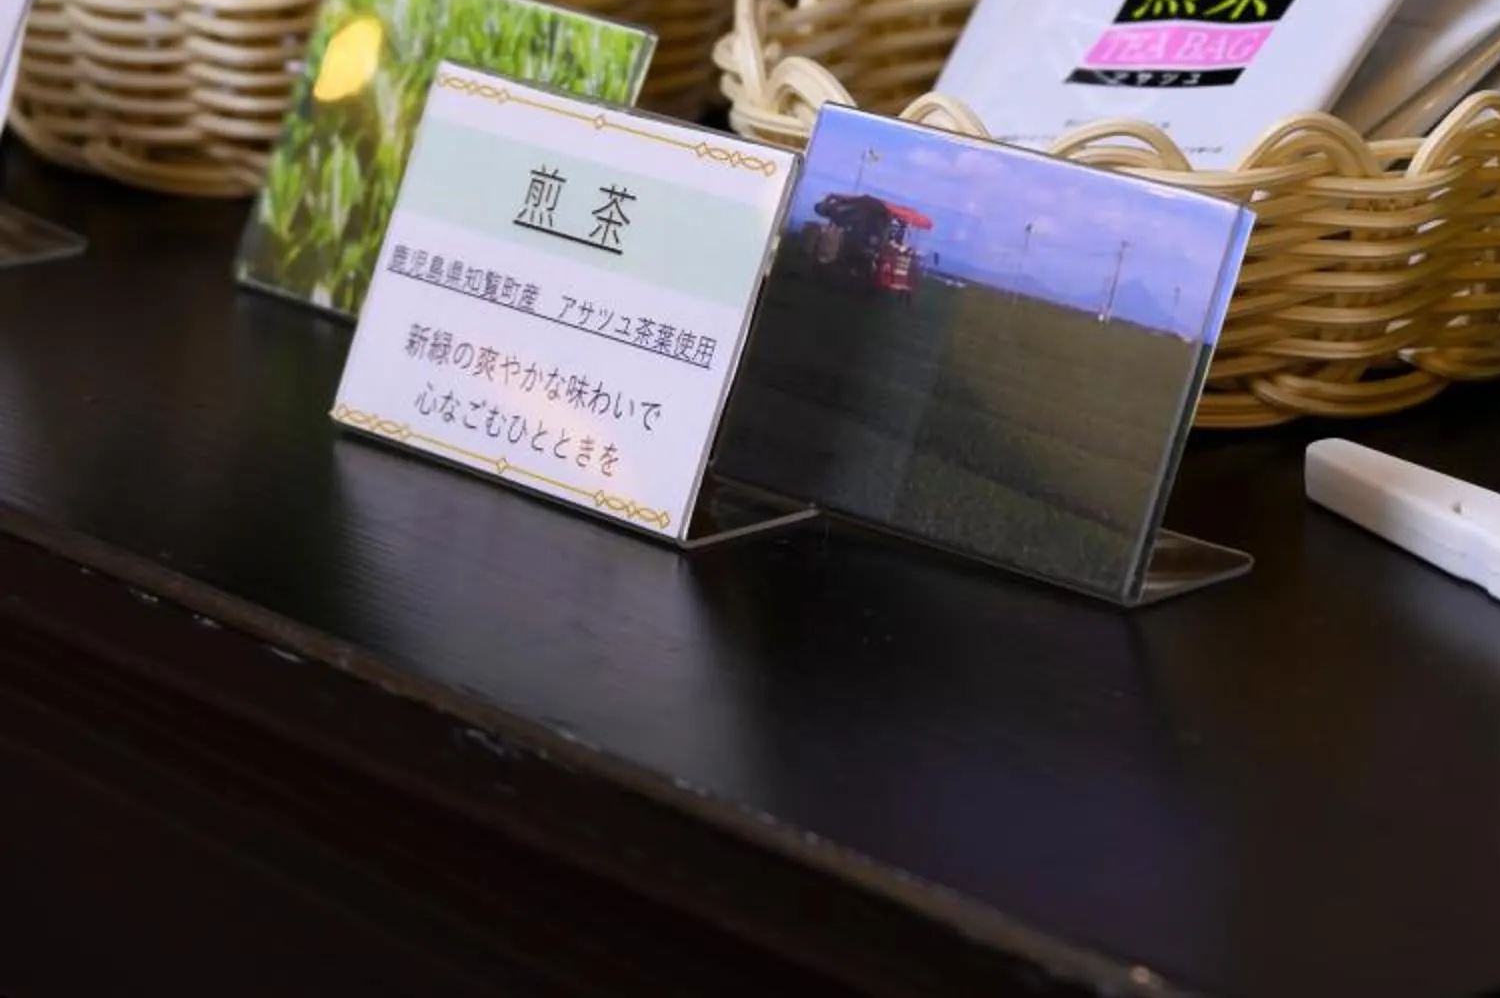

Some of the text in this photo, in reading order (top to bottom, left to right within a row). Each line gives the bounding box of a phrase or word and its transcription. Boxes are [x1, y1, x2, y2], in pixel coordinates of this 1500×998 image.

[1100, 30, 1261, 62] TEA BAG
[517, 165, 637, 249] 煎茶
[388, 243, 718, 367] 鹿児島県知覧町産 アサツユ茶葉使用
[403, 323, 663, 431] 新緑の爽やかな味わいで
[413, 381, 622, 476] 心なごむひとときを
